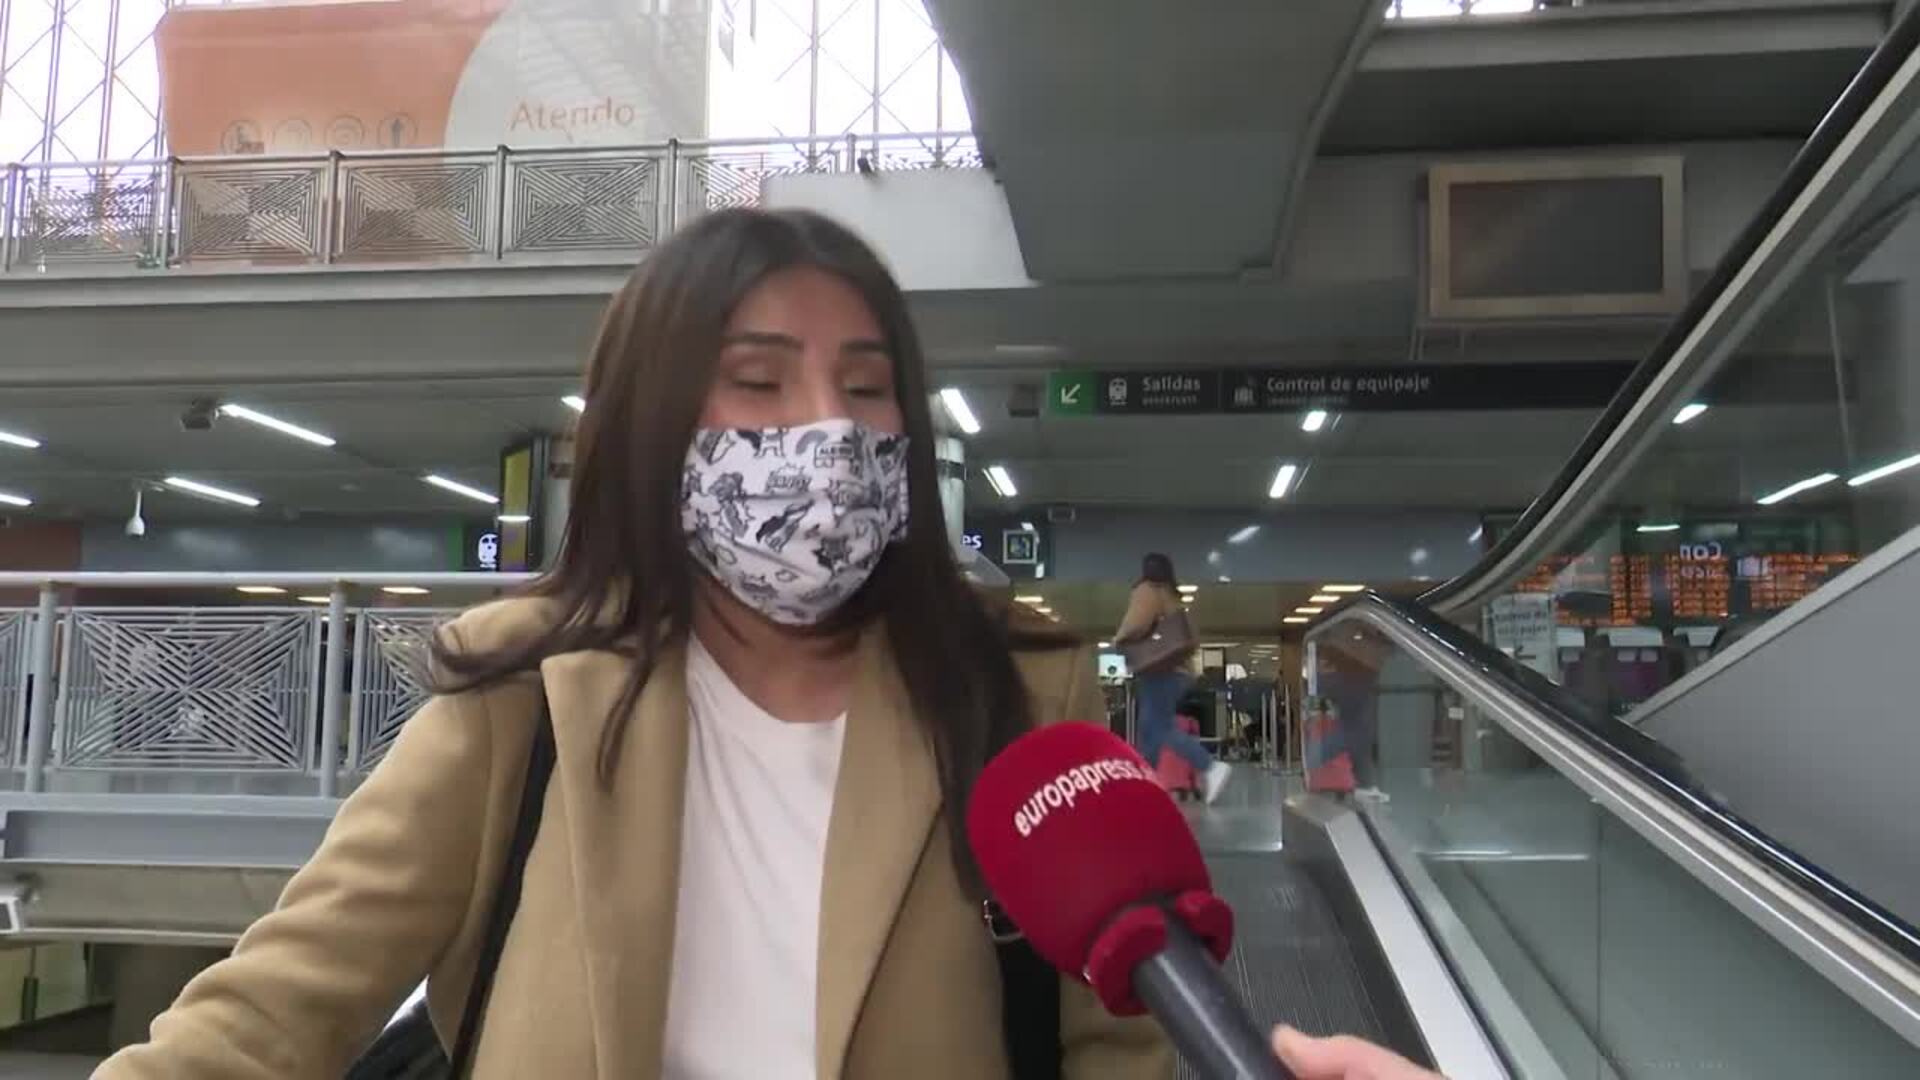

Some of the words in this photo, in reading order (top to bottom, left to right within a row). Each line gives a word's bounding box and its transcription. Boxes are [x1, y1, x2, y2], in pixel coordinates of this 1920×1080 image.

[510, 95, 636, 131] Atendo
[1142, 375, 1201, 392] Salidas
[1267, 376, 1326, 393] Control
[1331, 376, 1352, 392] de
[1357, 373, 1431, 394] equipaje
